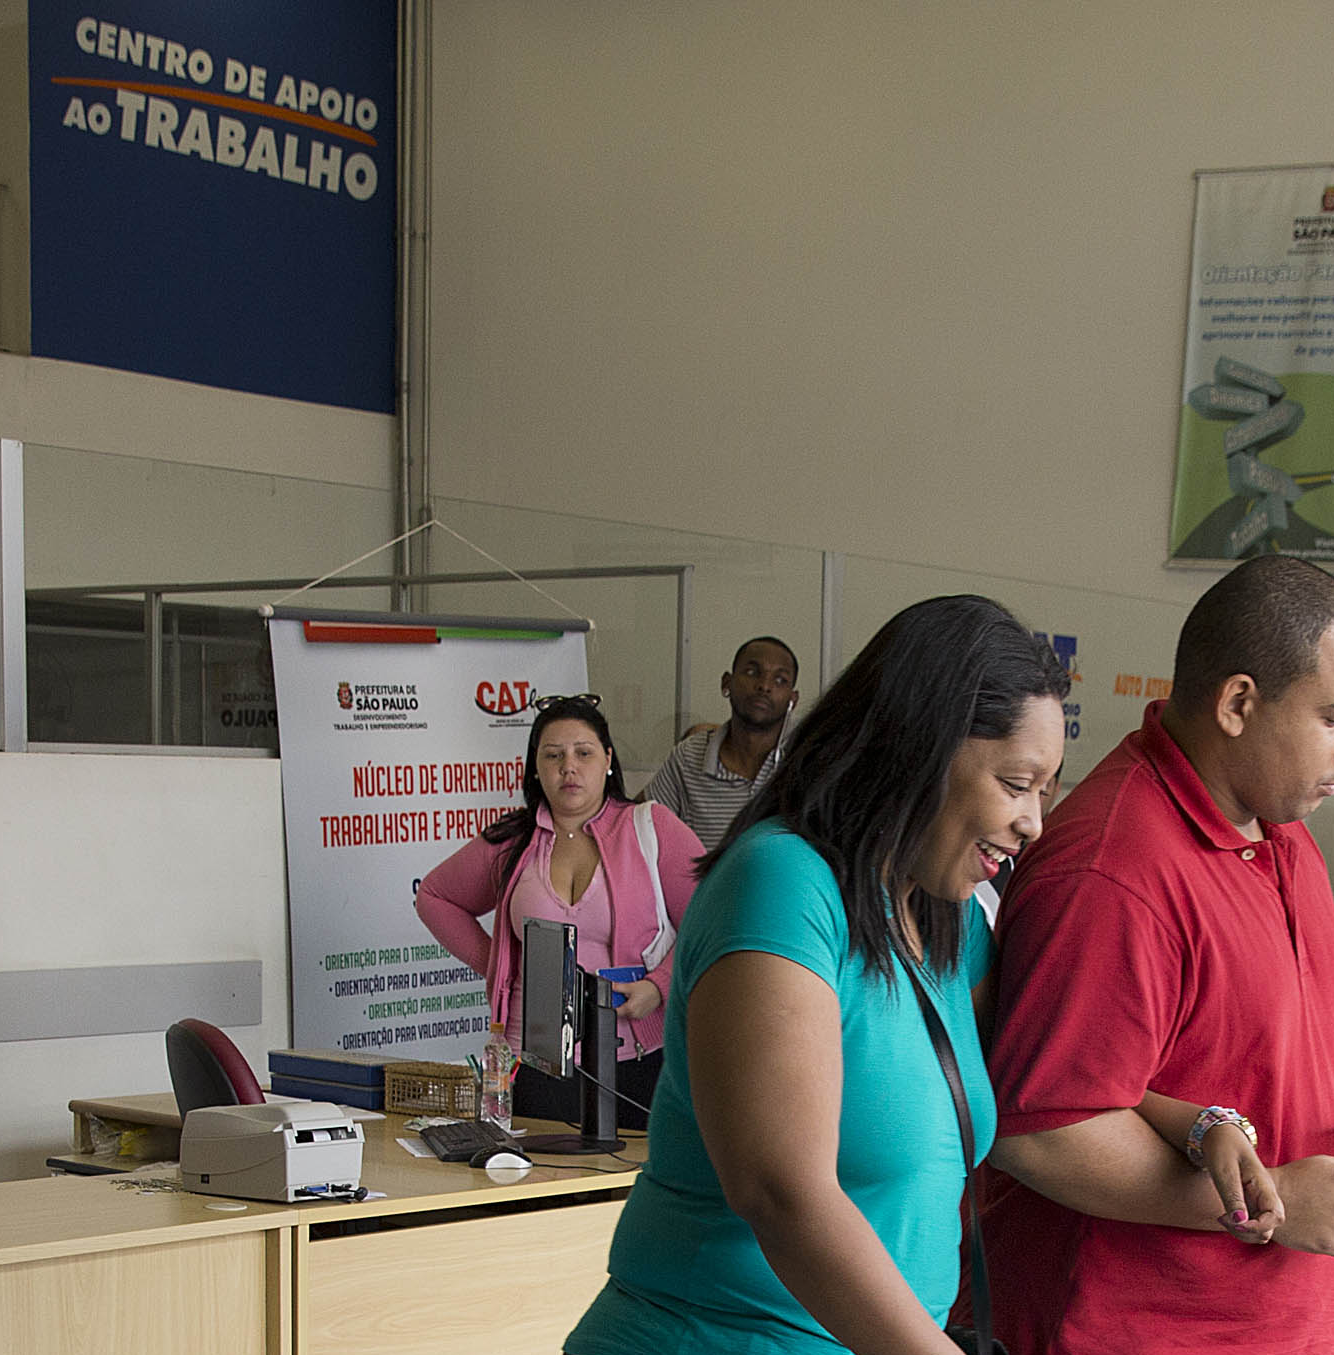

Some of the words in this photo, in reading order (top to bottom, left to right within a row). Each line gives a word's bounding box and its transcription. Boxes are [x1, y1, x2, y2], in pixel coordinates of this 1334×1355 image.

[75, 16, 214, 85] CENTRO
[224, 57, 267, 101] DE
[274, 74, 378, 132] APOIO
[63, 97, 112, 135] AO
[116, 88, 379, 201] TRABALHO
[1292, 226, 1318, 241] SÃO
[354, 684, 404, 696] PREFEITURA
[405, 685, 417, 695] DE
[1114, 673, 1142, 697] AUTO
[355, 694, 380, 711] SÃO
[382, 696, 419, 711] PAULO
[333, 723, 365, 731] TRABALHO
[352, 760, 414, 799] NÚCLEO
[418, 764, 439, 796] DE
[442, 756, 525, 798] ORIENTAÇÃ
[319, 812, 429, 850] TRABALHISTA
[433, 811, 441, 838] E
[325, 947, 376, 971] ORIENTAÇÃO
[378, 950, 401, 967] PARA
[403, 948, 409, 963] O
[334, 974, 385, 998] ORIENTAÇÃO
[387, 974, 410, 991] PARA
[411, 973, 418, 989] O
[368, 996, 418, 1020] ORIENTAÇÃO
[420, 996, 442, 1014] PARA
[443, 990, 488, 1010] IMIGRANTES
[342, 1025, 393, 1051] ORIENTAÇÃO
[395, 1025, 417, 1043] PARA
[418, 1016, 470, 1040] VALORIZAÇÃO
[472, 1017, 483, 1033] DO
